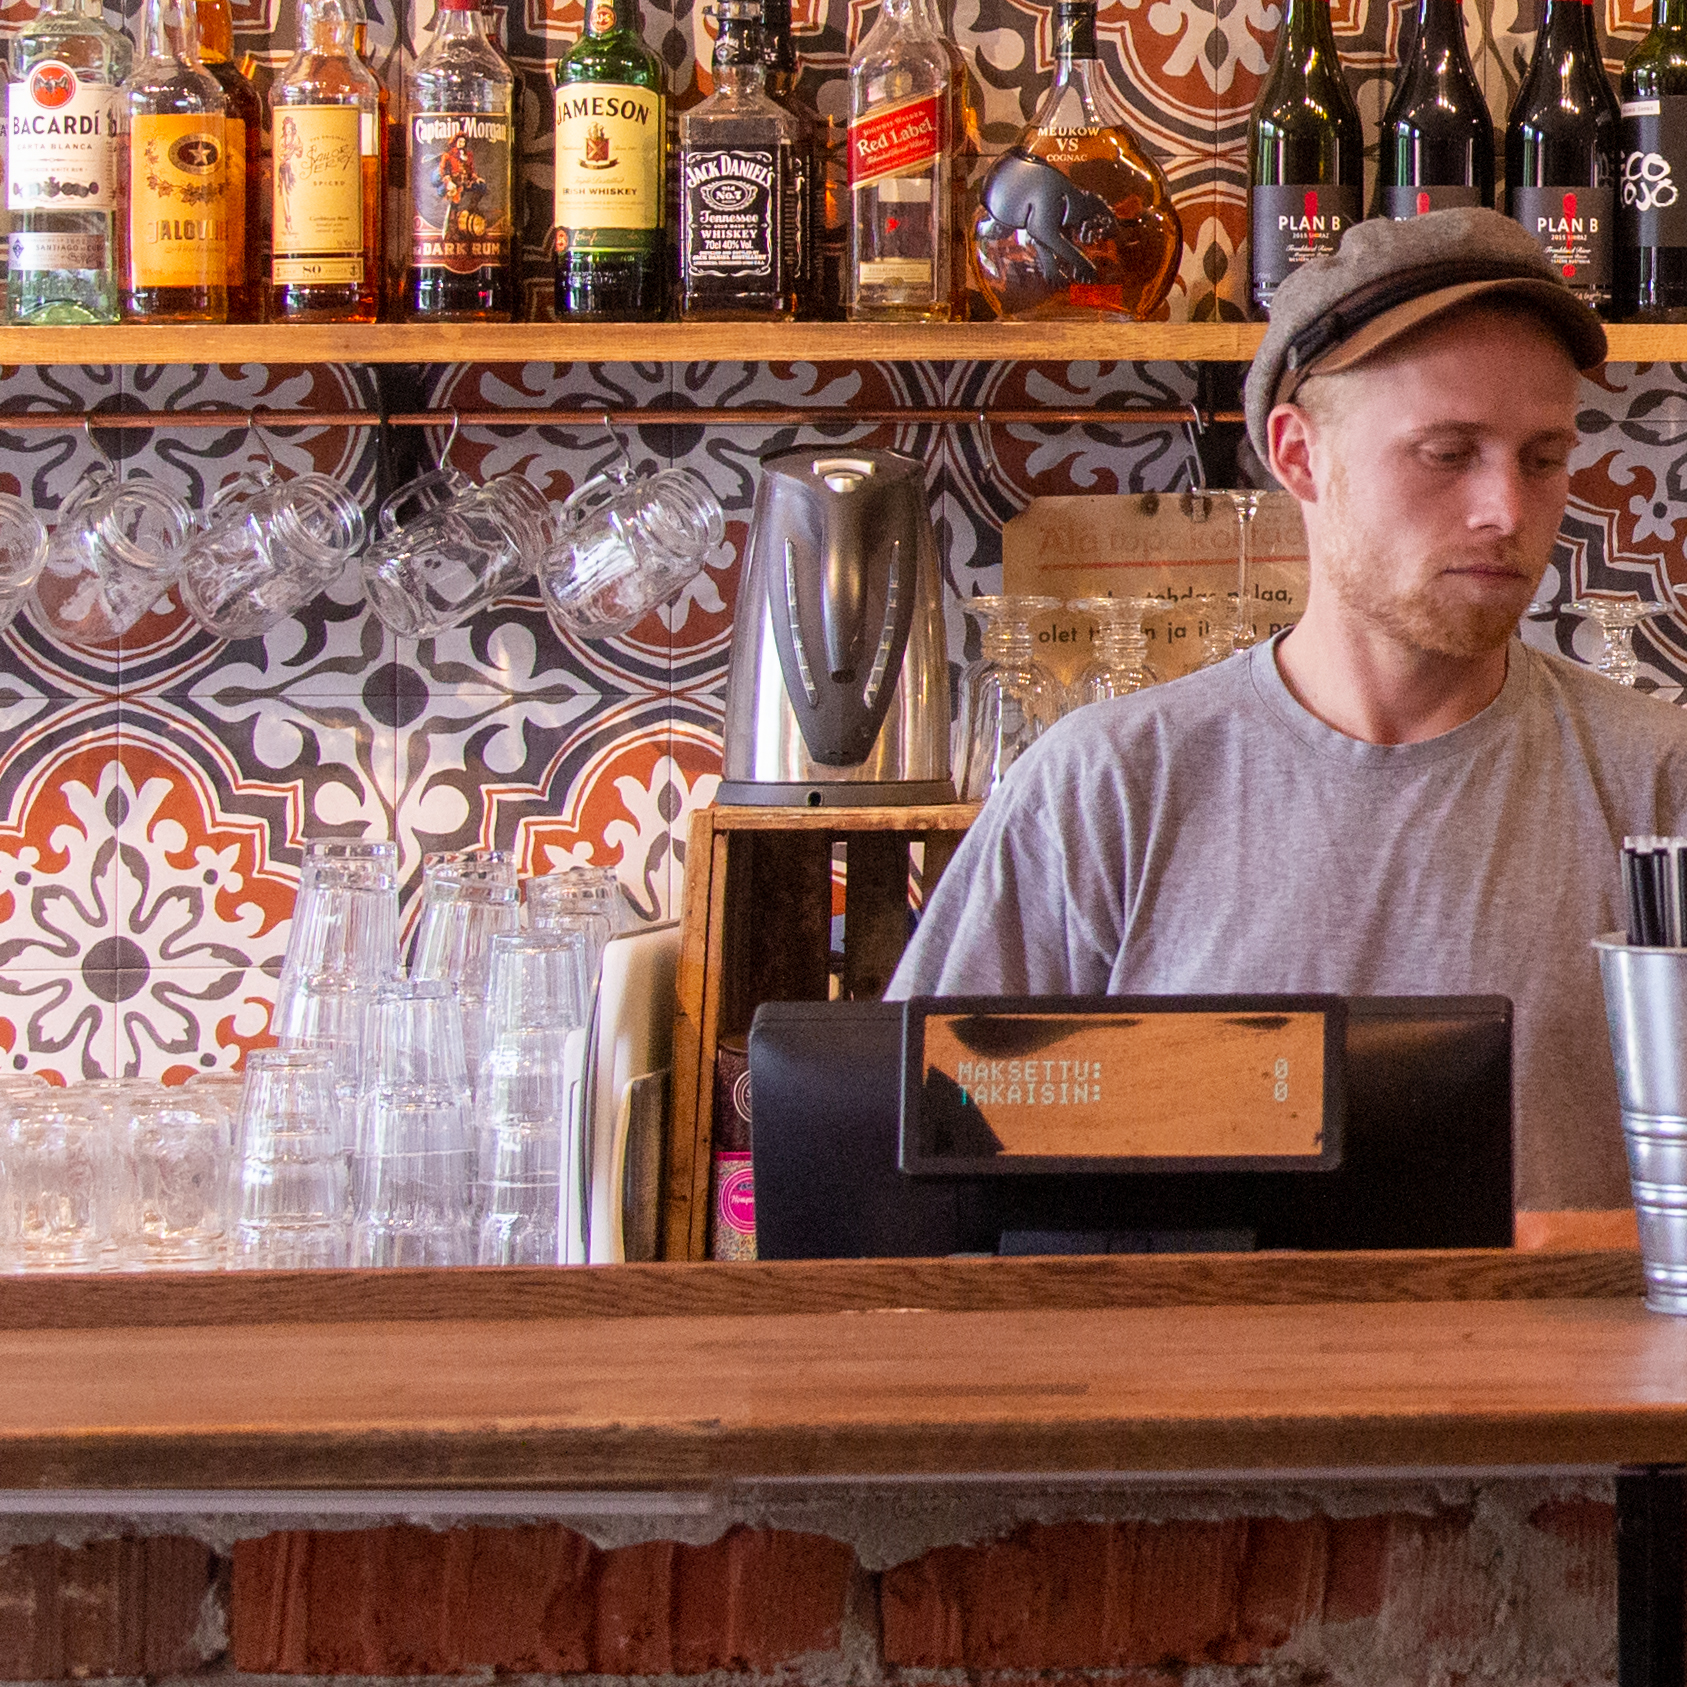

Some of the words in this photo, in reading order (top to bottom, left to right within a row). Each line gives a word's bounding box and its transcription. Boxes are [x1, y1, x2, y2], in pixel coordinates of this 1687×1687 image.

[557, 97, 650, 126] JAMESON
[13, 109, 101, 136] BACARDÍ
[856, 132, 889, 156] Red
[889, 116, 933, 144] Label
[1037, 126, 1100, 137] MEUKOW
[50, 143, 93, 151] BLANCA
[1056, 138, 1079, 152] VS
[1046, 153, 1088, 162] COGNAC
[685, 160, 721, 189] JACK
[588, 187, 638, 196] WHISKEY
[700, 210, 759, 224] Tennessee
[1278, 215, 1325, 231] PLAN
[1331, 215, 1341, 231] B
[1537, 217, 1583, 233] PLAN
[1589, 217, 1599, 233] B
[700, 229, 758, 239] WHISKEY
[423, 242, 467, 256] DARK
[472, 242, 501, 255] RUM
[722, 240, 740, 250] 40%
[1038, 624, 1077, 643] olet
[957, 1060, 1102, 1080] MAKSETTU:
